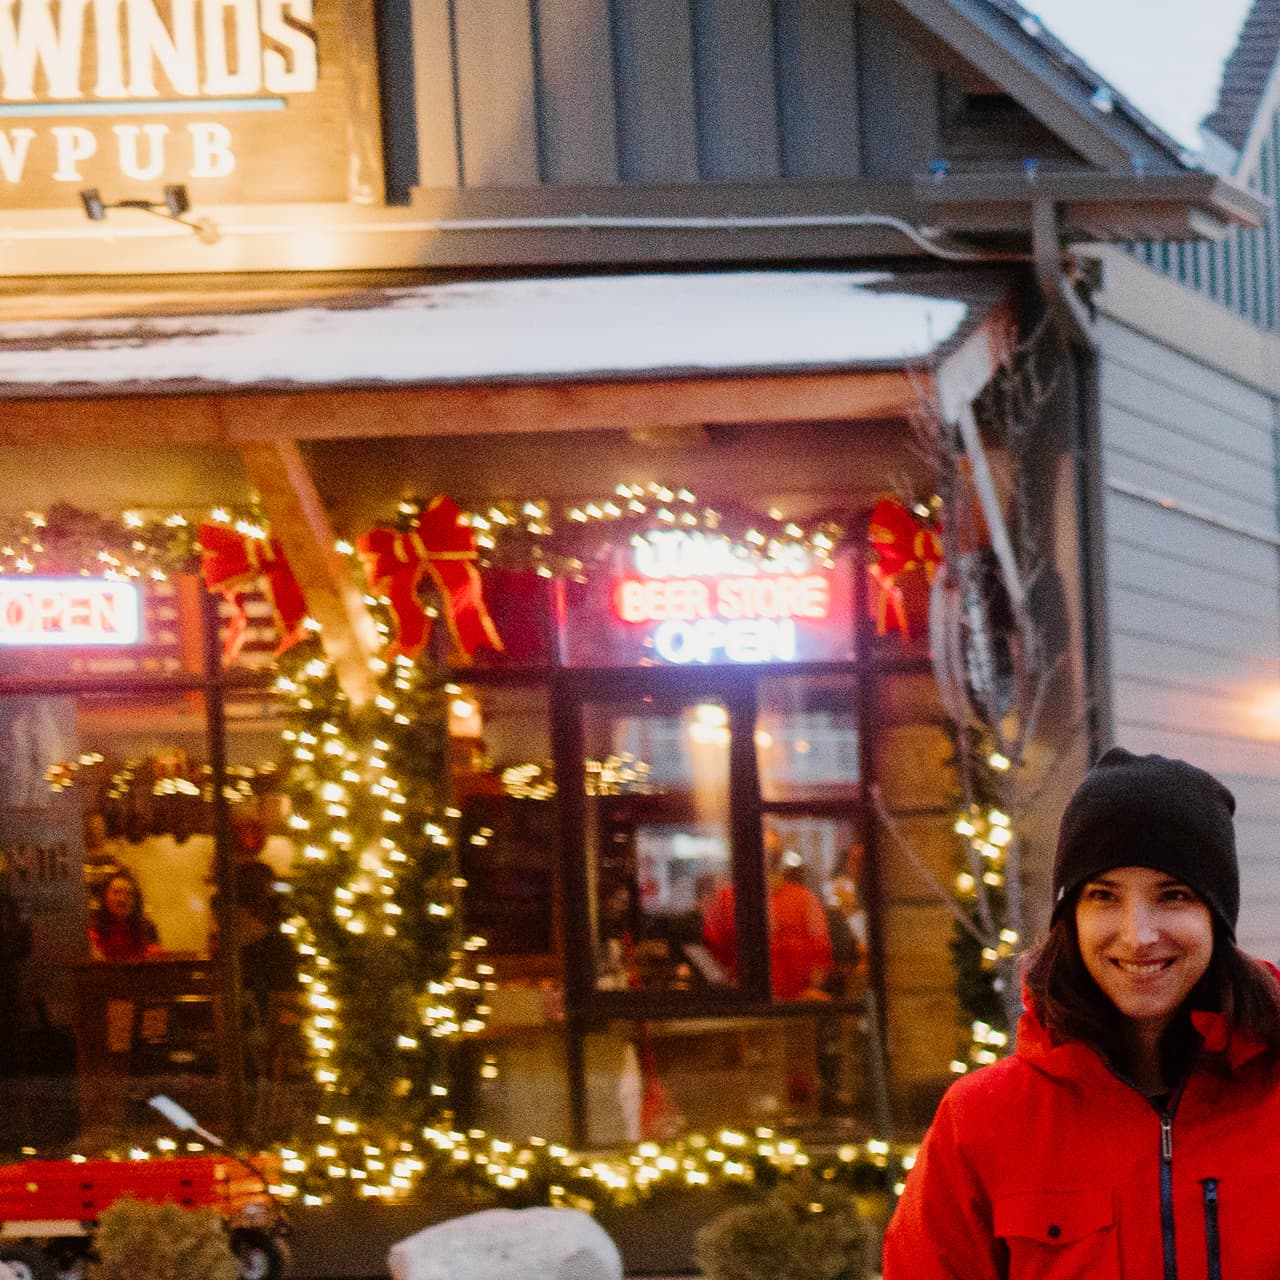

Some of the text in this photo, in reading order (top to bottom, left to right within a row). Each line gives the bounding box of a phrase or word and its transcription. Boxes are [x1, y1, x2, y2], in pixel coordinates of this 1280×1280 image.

[0, 590, 120, 635] OPEN
[621, 576, 828, 622] BEER STORE
[655, 618, 796, 664] OPEN
